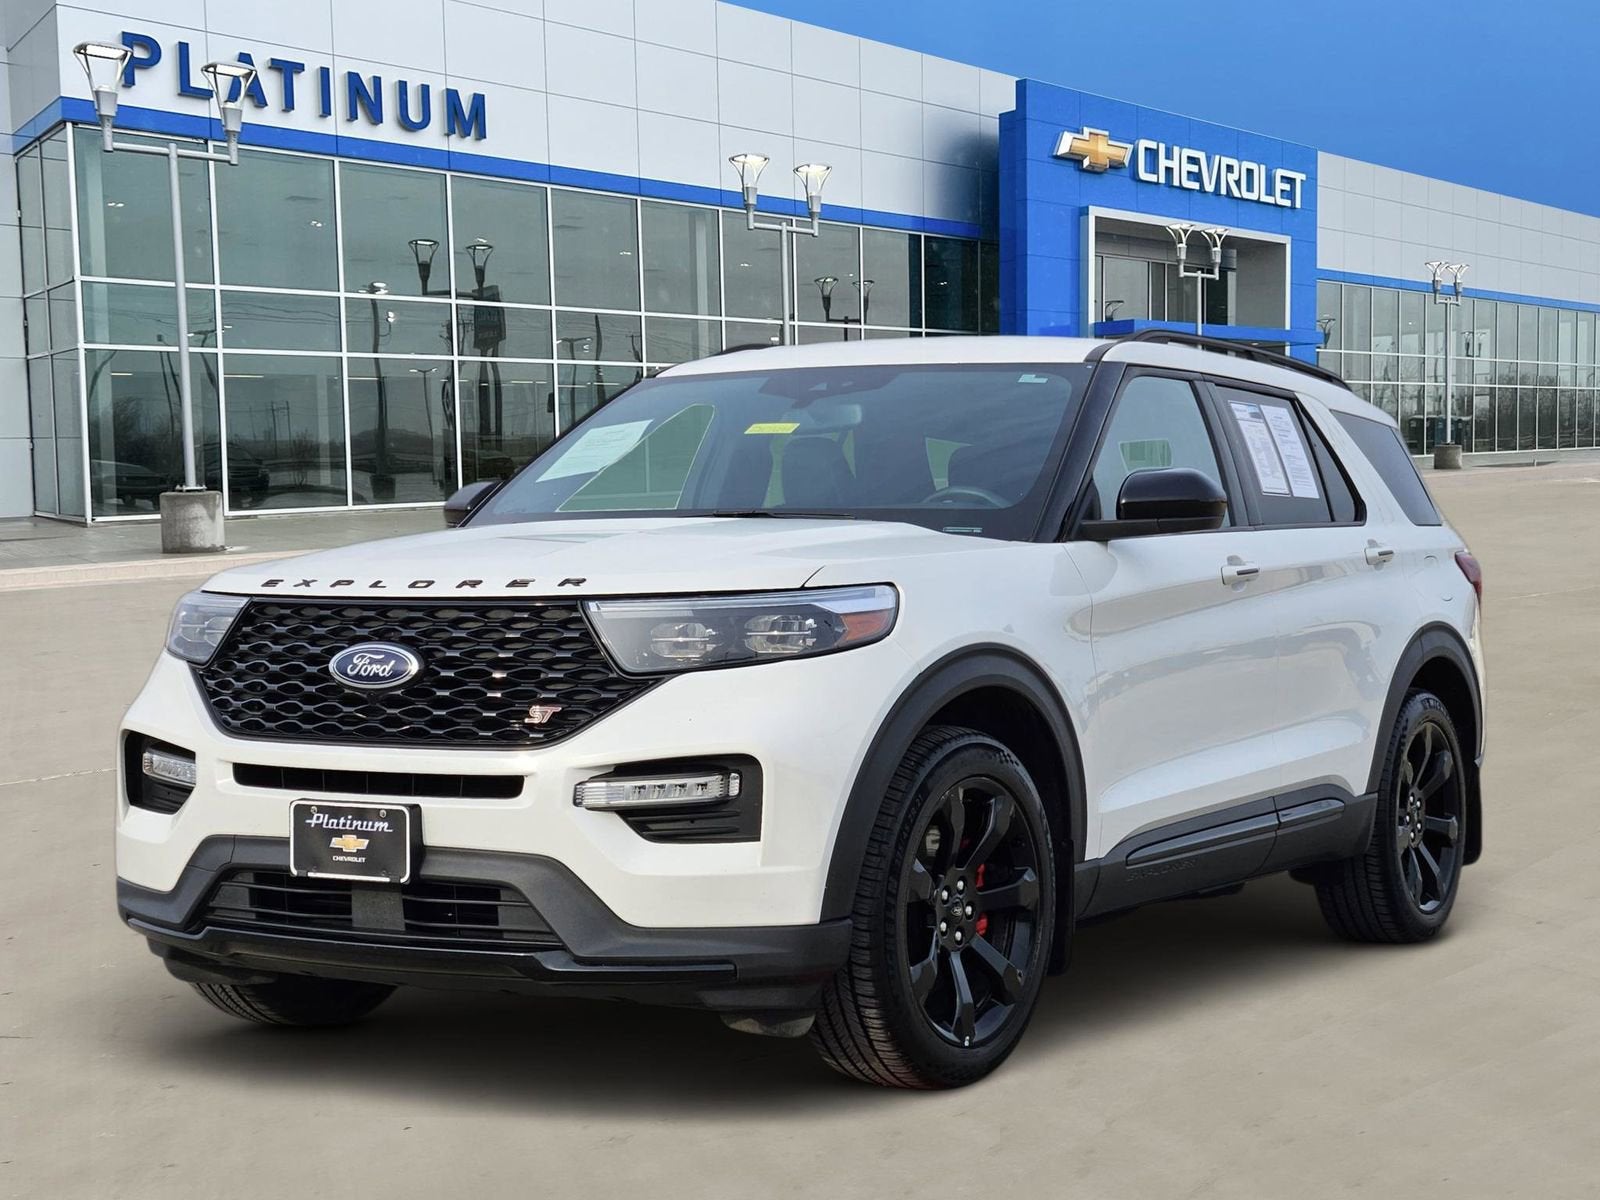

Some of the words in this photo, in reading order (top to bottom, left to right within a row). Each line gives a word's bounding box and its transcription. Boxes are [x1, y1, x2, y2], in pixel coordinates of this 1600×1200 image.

[121, 31, 487, 140] PLATINUM
[1136, 139, 1306, 209] CHEVROLET
[261, 578, 587, 589] EXPLORER
[347, 653, 395, 677] Ford
[525, 705, 562, 724] ST
[305, 813, 393, 832] Platinum
[332, 855, 366, 863] CHEVROLET
